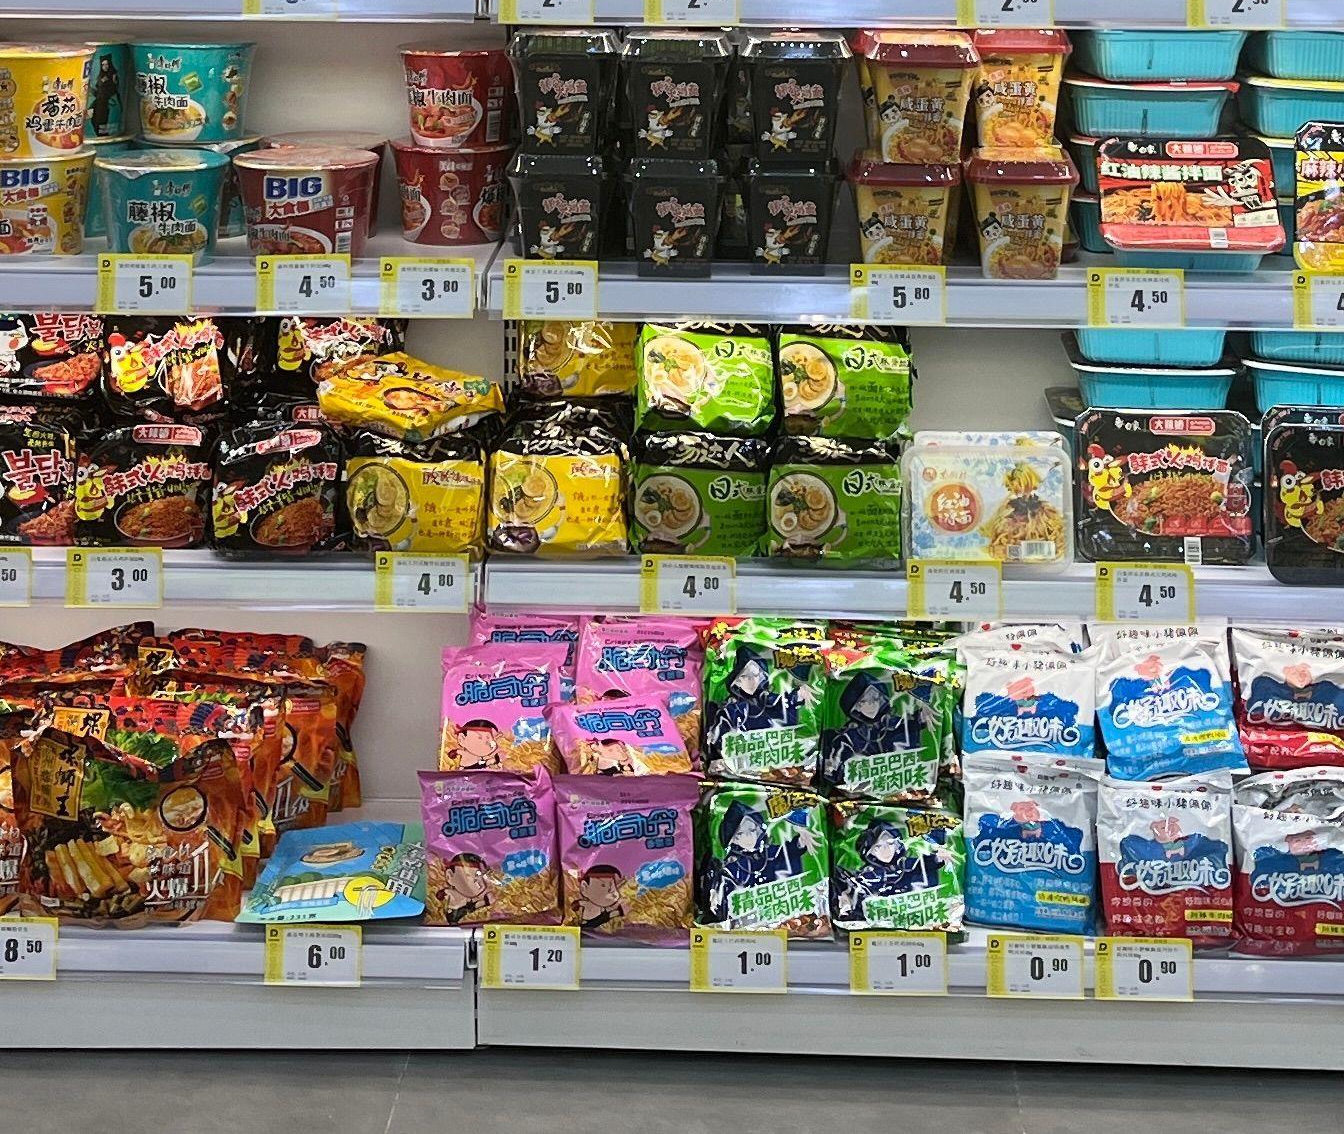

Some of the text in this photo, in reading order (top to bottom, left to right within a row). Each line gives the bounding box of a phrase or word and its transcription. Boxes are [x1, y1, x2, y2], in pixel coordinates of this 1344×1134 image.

[994, 82, 1036, 96] 咸蛋黄
[152, 95, 188, 109] 牛肉面
[900, 97, 945, 112] 咸蛋黄
[0, 168, 50, 189] BIG
[1100, 161, 1224, 182] 红油辣酱拌面
[264, 177, 323, 200] BIG
[129, 202, 175, 222] 藤椒
[884, 216, 928, 229] 咸蛋黄
[1001, 215, 1045, 228] 咸蛋黄
[158, 220, 196, 235] 牛肉面
[139, 276, 176, 298] 5.00
[299, 275, 336, 296] 4.50
[1131, 290, 1168, 312] 4.50
[1127, 449, 1229, 474] 韩式火鸡拌面
[112, 569, 148, 590] 3.00
[949, 581, 986, 603] 4.50
[1139, 583, 1176, 607] 4.50
[308, 944, 345, 969] 6.00
[529, 948, 562, 972] 1.20
[1139, 958, 1176, 982] 0.90
